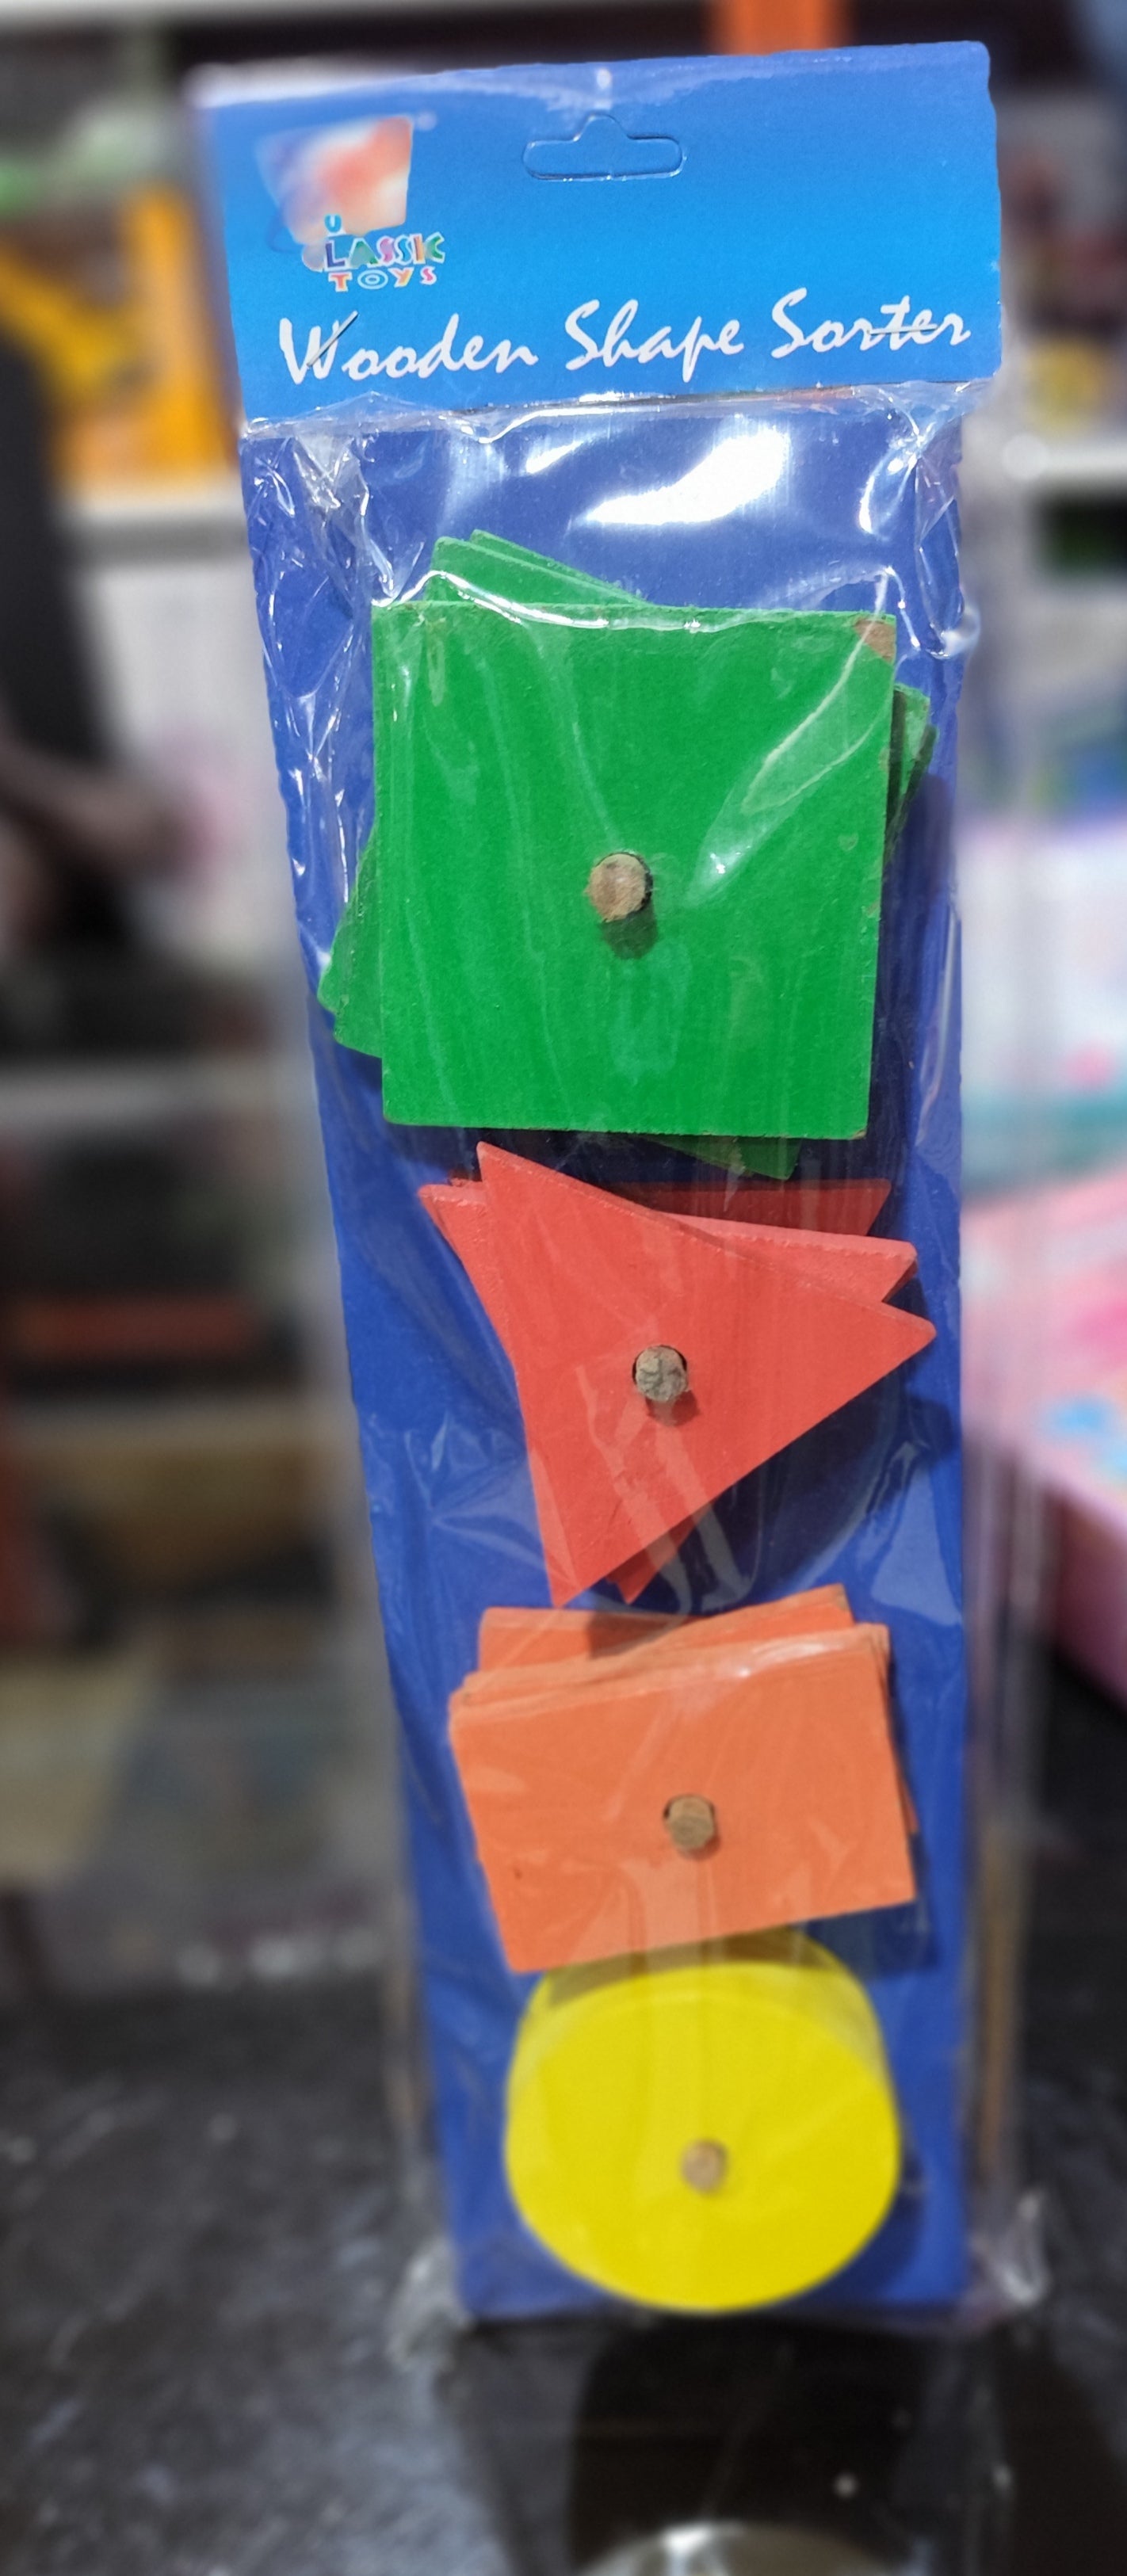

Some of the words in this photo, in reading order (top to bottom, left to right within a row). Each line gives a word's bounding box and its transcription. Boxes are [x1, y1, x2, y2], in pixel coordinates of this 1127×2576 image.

[303, 231, 445, 272] LASSIC
[327, 265, 437, 292] TOYS
[279, 312, 539, 385] Wooden
[564, 299, 745, 384] Shape
[770, 287, 972, 359] Sorter
